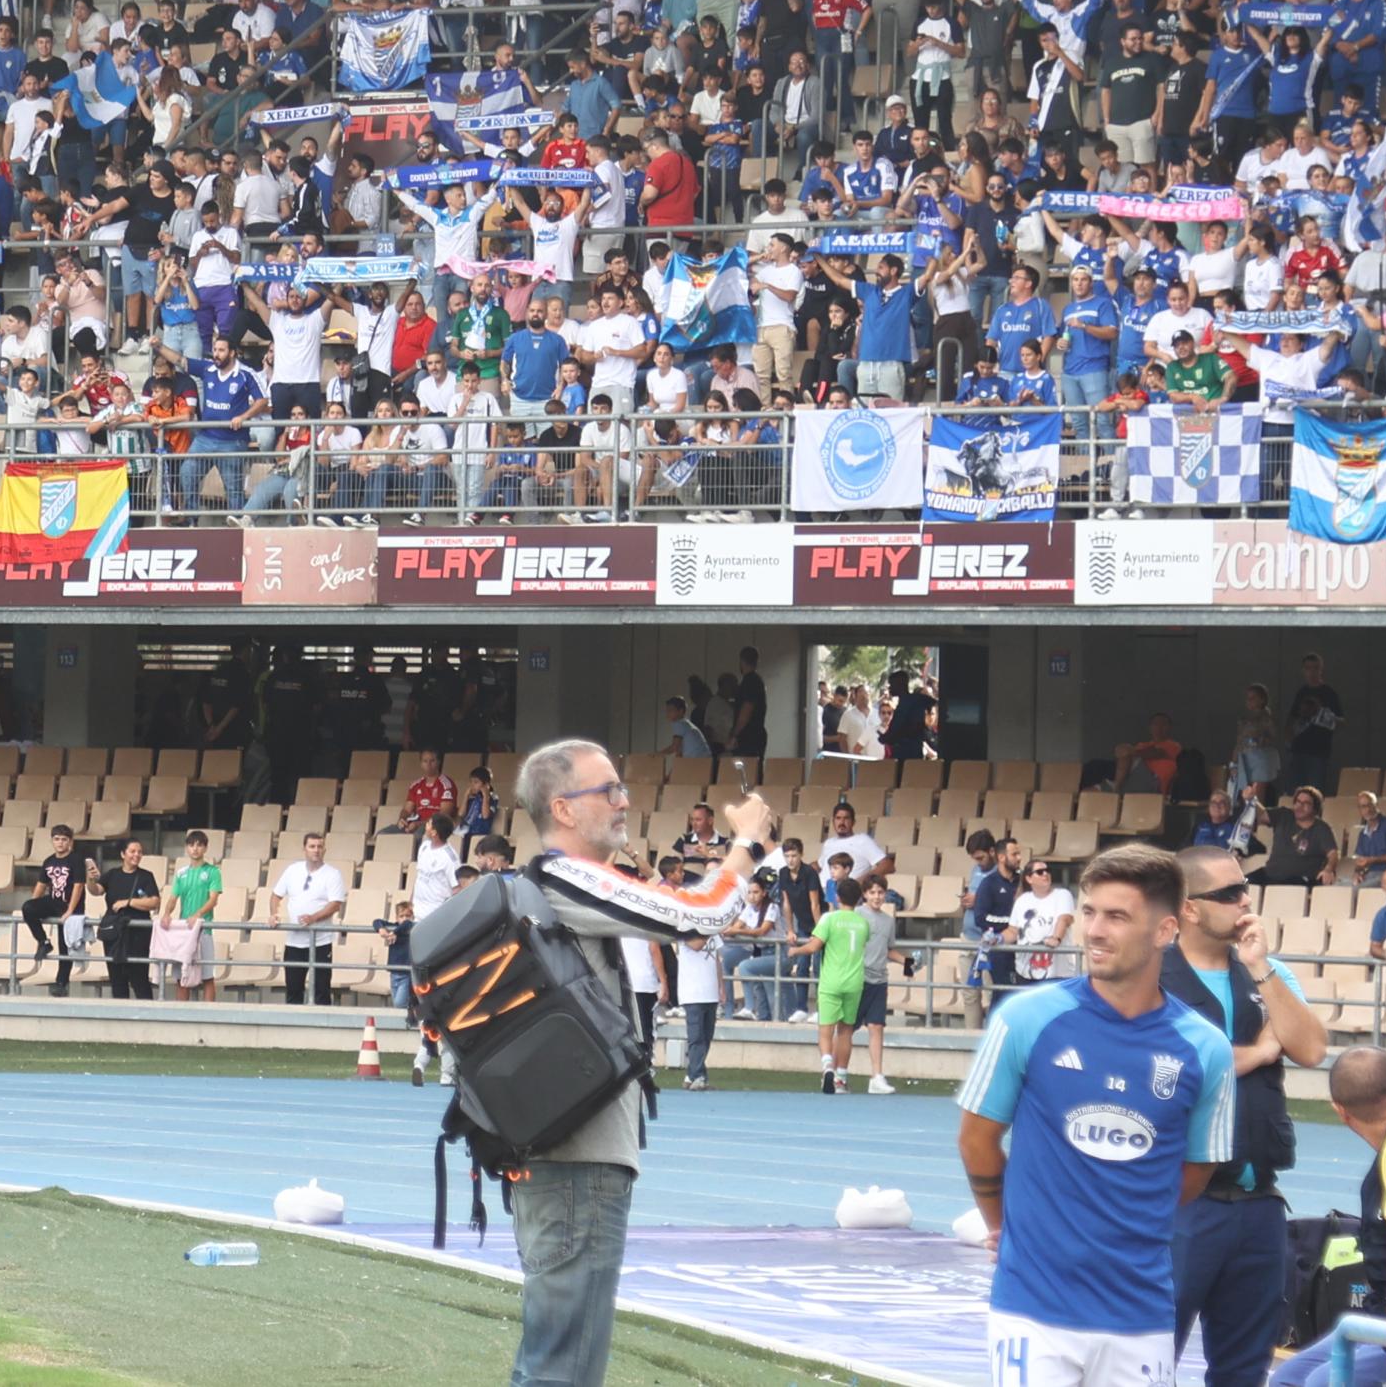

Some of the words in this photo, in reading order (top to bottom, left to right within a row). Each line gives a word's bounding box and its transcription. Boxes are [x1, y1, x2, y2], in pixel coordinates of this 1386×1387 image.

[344, 114, 431, 141] PLAY
[377, 242, 395, 255] 213
[832, 233, 903, 247] XEREZ
[926, 492, 987, 514] KOMANDO
[996, 493, 1055, 514] CABALLO
[265, 545, 283, 591] SIN
[395, 548, 496, 579] PLAY
[476, 536, 611, 596] JEREZ
[704, 555, 780, 567] Ayuntamiento
[810, 546, 911, 578] PLAY
[893, 534, 1029, 596] JEREZ
[1123, 551, 1200, 564] Ayuntamiento
[62, 549, 198, 597] JEREZ
[318, 564, 365, 593] Xerez
[704, 568, 716, 580] de
[719, 569, 746, 581] Jerez
[1123, 565, 1136, 577] de
[1138, 566, 1166, 579] Jerez
[1213, 540, 1371, 599] zcampo
[531, 657, 546, 669] 112
[1107, 1076, 1126, 1093] 14
[1065, 1104, 1127, 1123] DISTRIBUCIONES
[1073, 1121, 1149, 1151] LUGO
[998, 1337, 1030, 1387] 14
